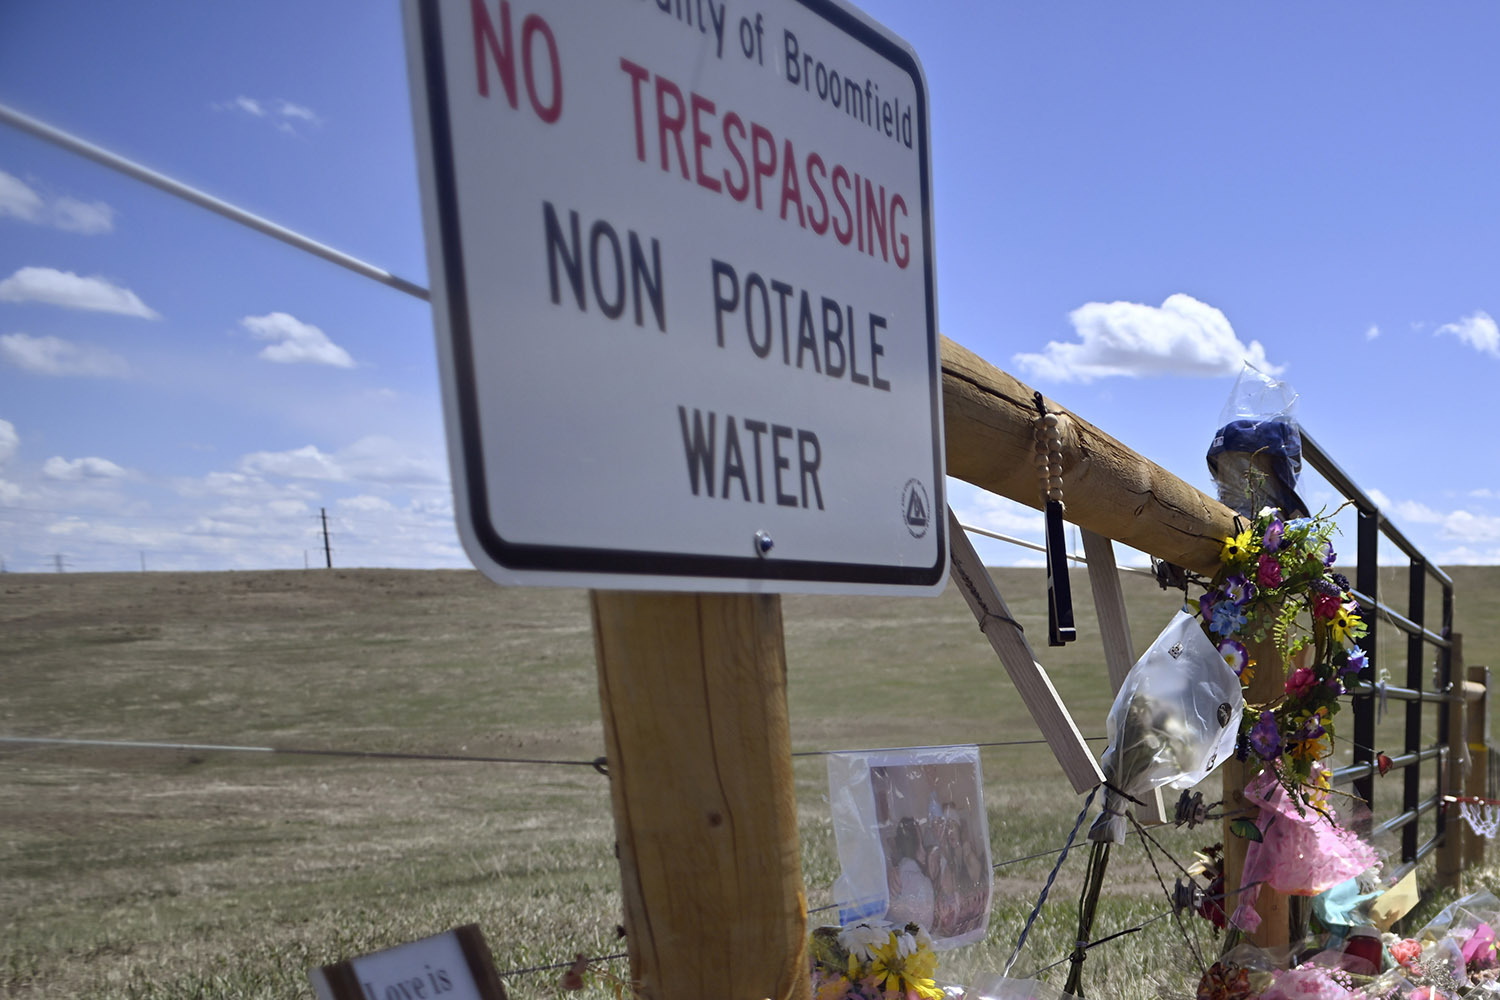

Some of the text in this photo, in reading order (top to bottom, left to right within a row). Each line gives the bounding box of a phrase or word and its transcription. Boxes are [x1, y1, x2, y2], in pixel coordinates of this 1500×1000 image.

[470, 0, 912, 270] NO TRESPASSING
[739, 12, 764, 67] of
[783, 28, 914, 150] Broomfield
[541, 200, 891, 392] NON POTABLE
[677, 404, 825, 511] WATER
[424, 965, 453, 995] is
